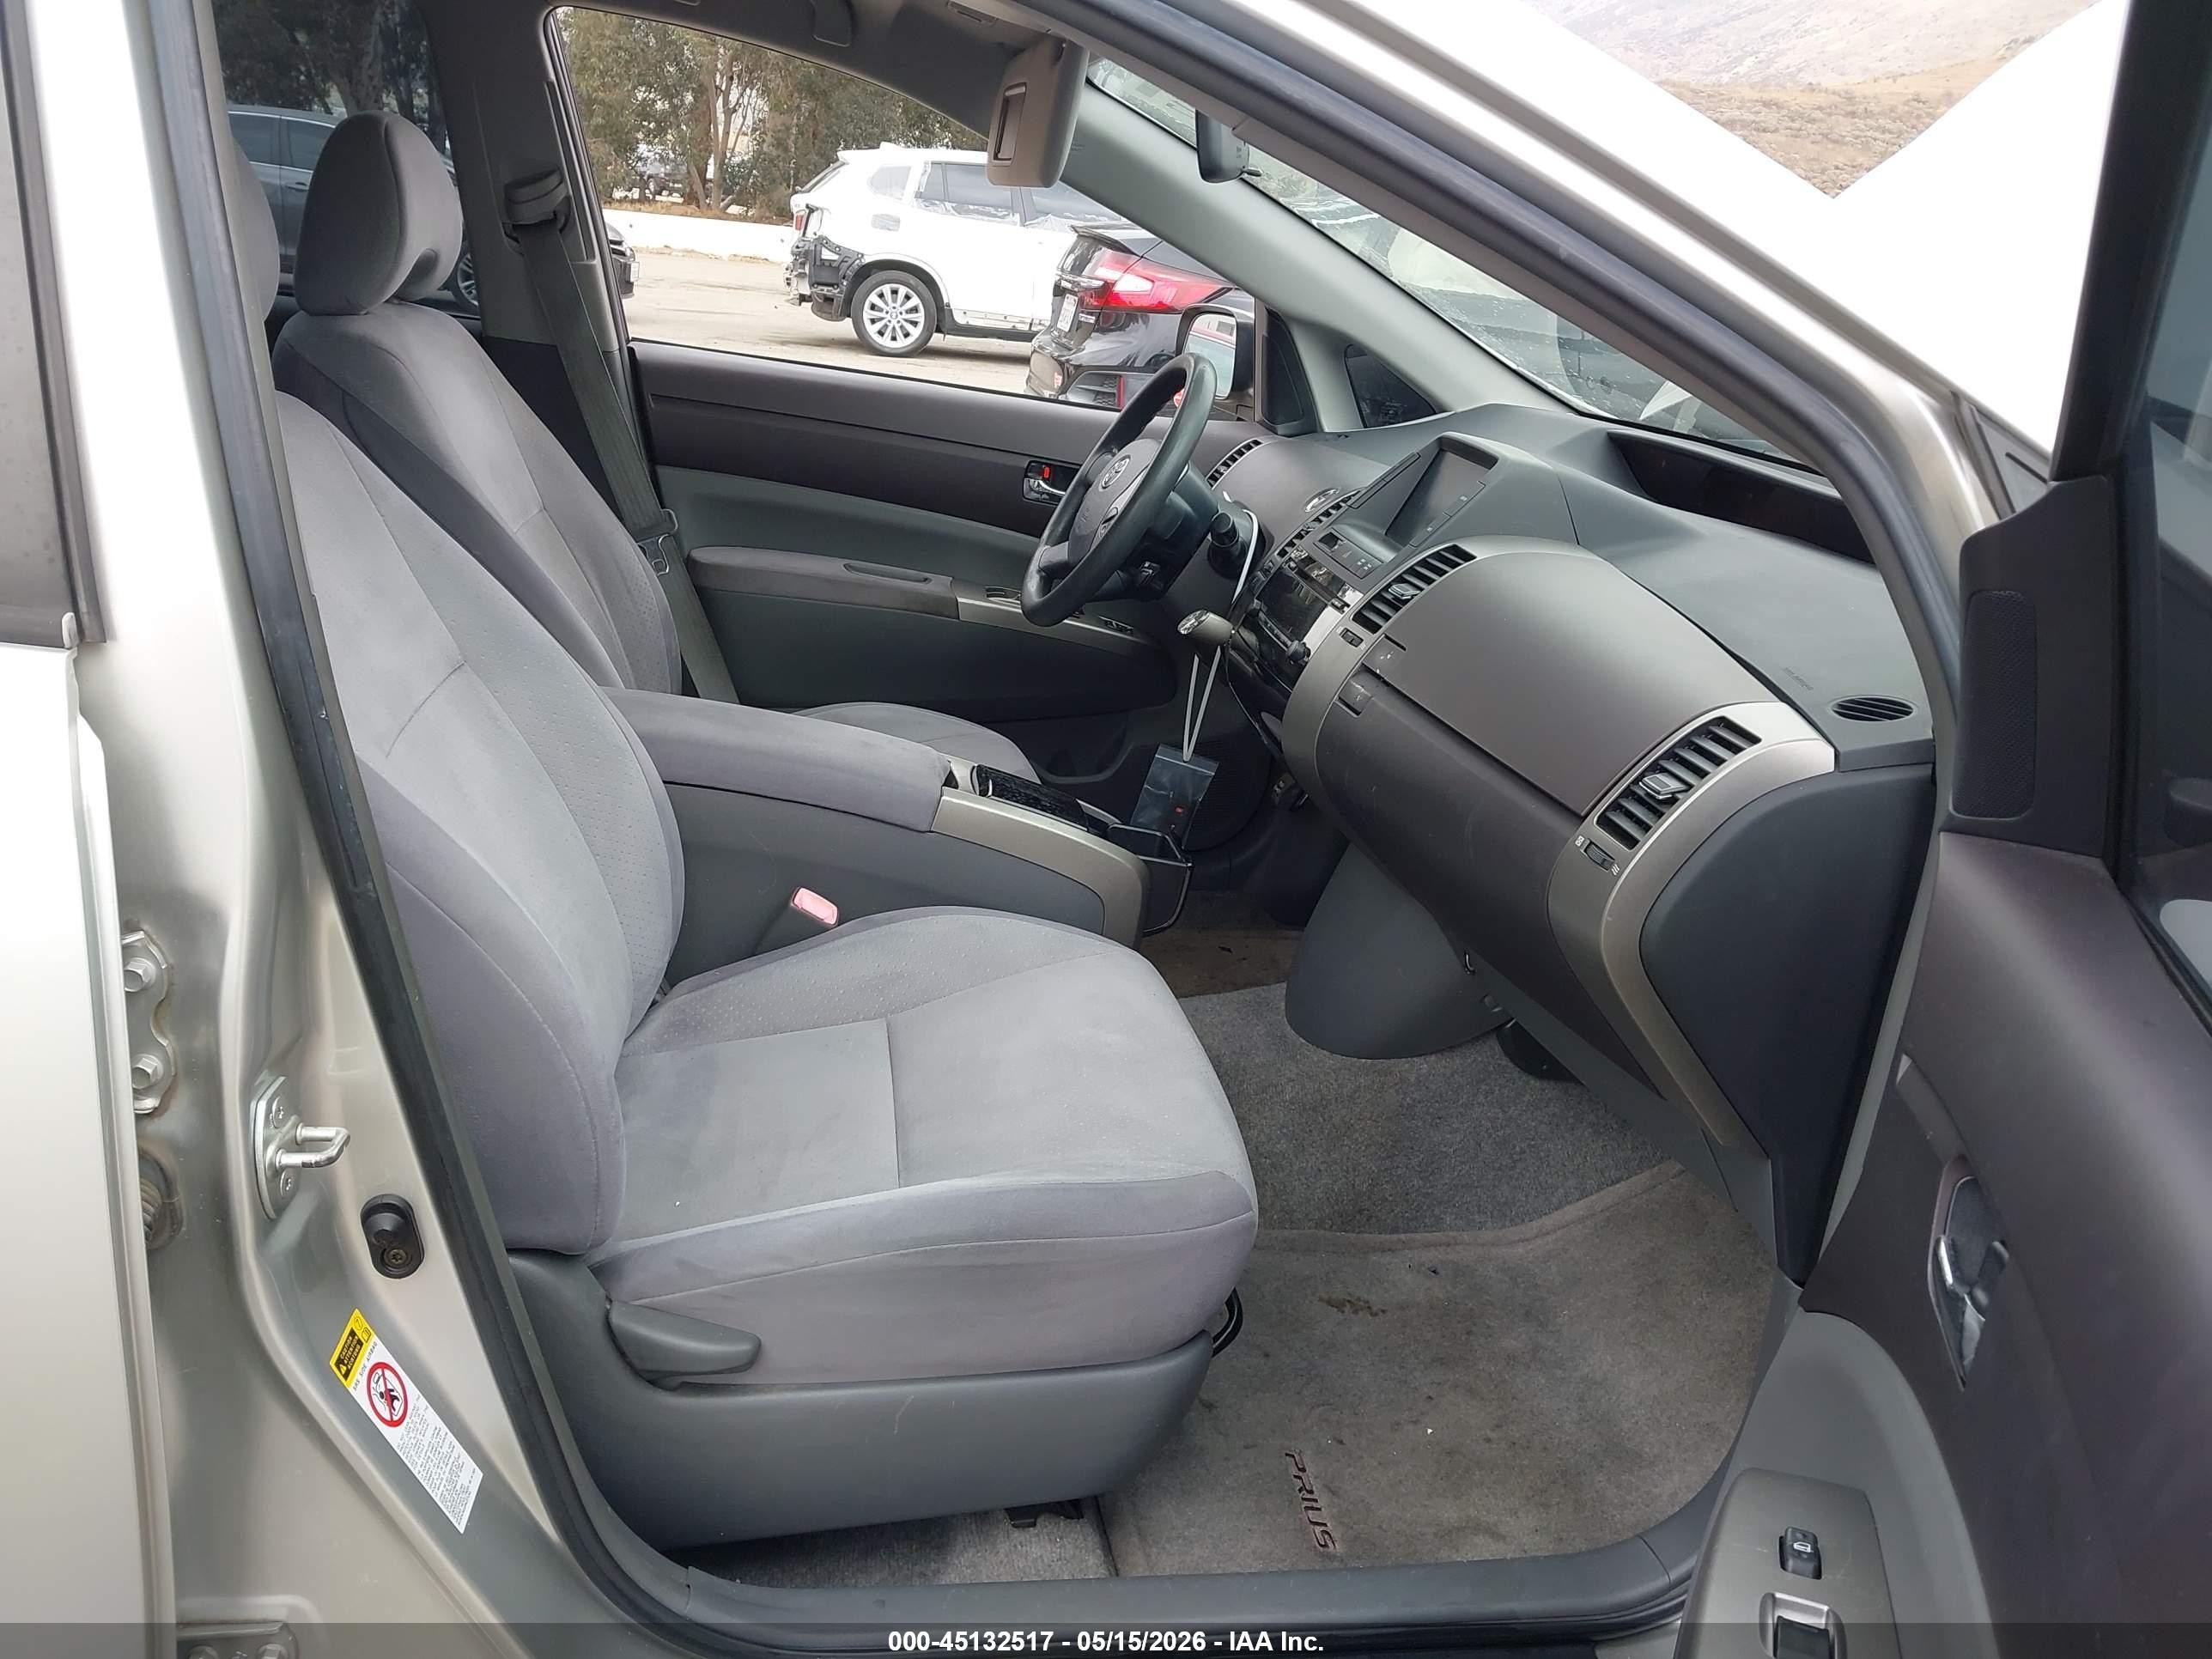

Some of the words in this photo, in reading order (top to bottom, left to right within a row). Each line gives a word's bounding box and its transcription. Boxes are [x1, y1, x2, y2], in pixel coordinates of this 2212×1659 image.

[340, 1336, 353, 1359] CAUTION
[343, 1336, 358, 1364] ATTENTION
[347, 1344, 361, 1370] ACHTUNG
[366, 1341, 378, 1361] AIRBAG
[1285, 1450, 1338, 1551] PRIUS
